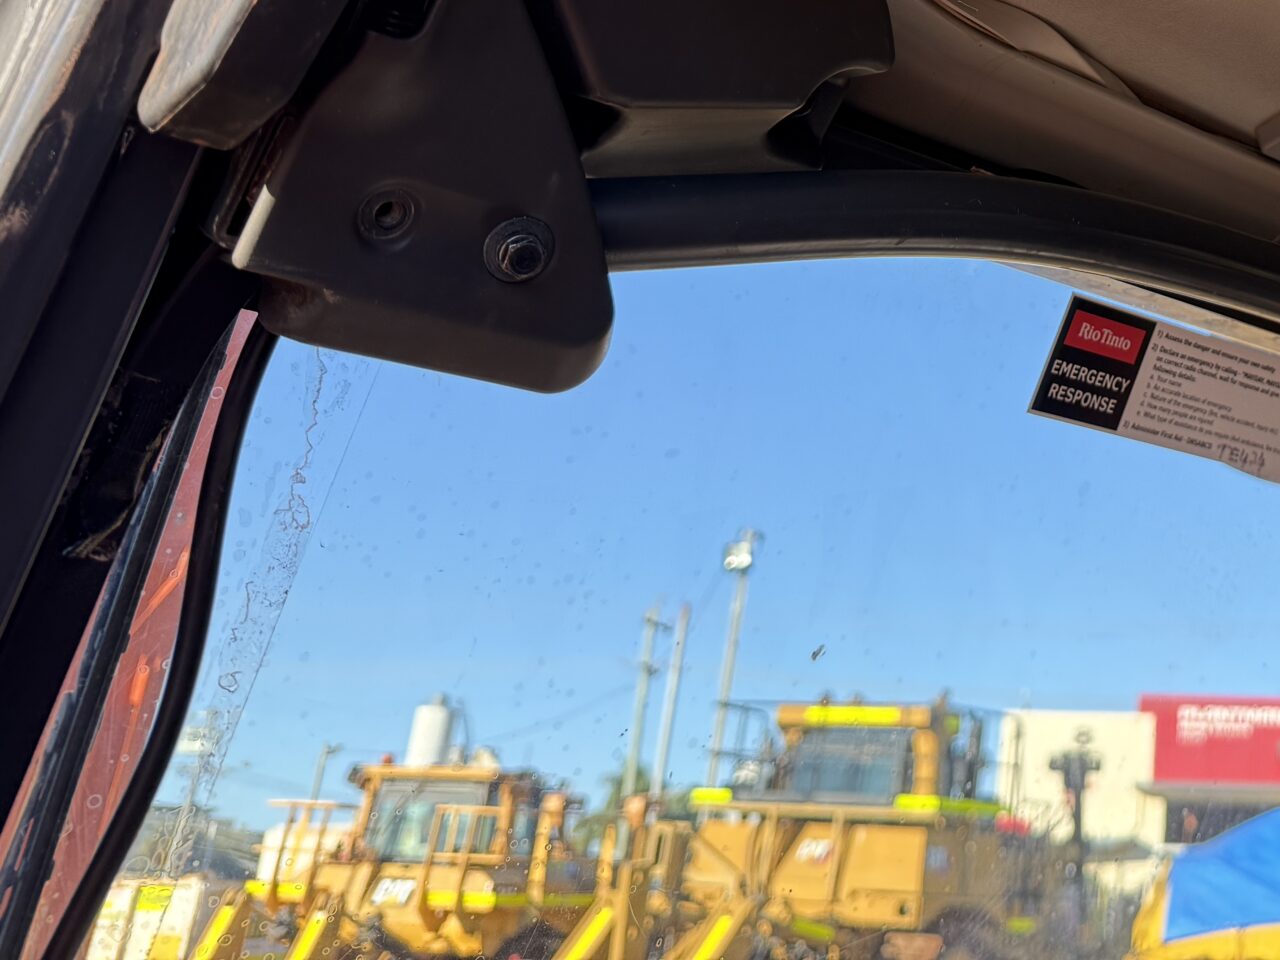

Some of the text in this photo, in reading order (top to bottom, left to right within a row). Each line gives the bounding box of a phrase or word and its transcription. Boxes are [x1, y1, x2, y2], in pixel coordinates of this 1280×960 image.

[1164, 332, 1182, 343] Assess
[1183, 338, 1192, 346] the
[1192, 342, 1210, 351] danger
[1051, 359, 1130, 393] EMERGENCY
[1159, 345, 1179, 357] Declare
[1186, 356, 1214, 368] emergency
[1221, 366, 1237, 376] calling
[1163, 358, 1183, 368] correct
[1182, 364, 1196, 372] radio
[1238, 381, 1259, 391] response
[1048, 383, 1117, 414] RESPONSE
[1168, 379, 1181, 387] name
[1160, 430, 1173, 439] First
